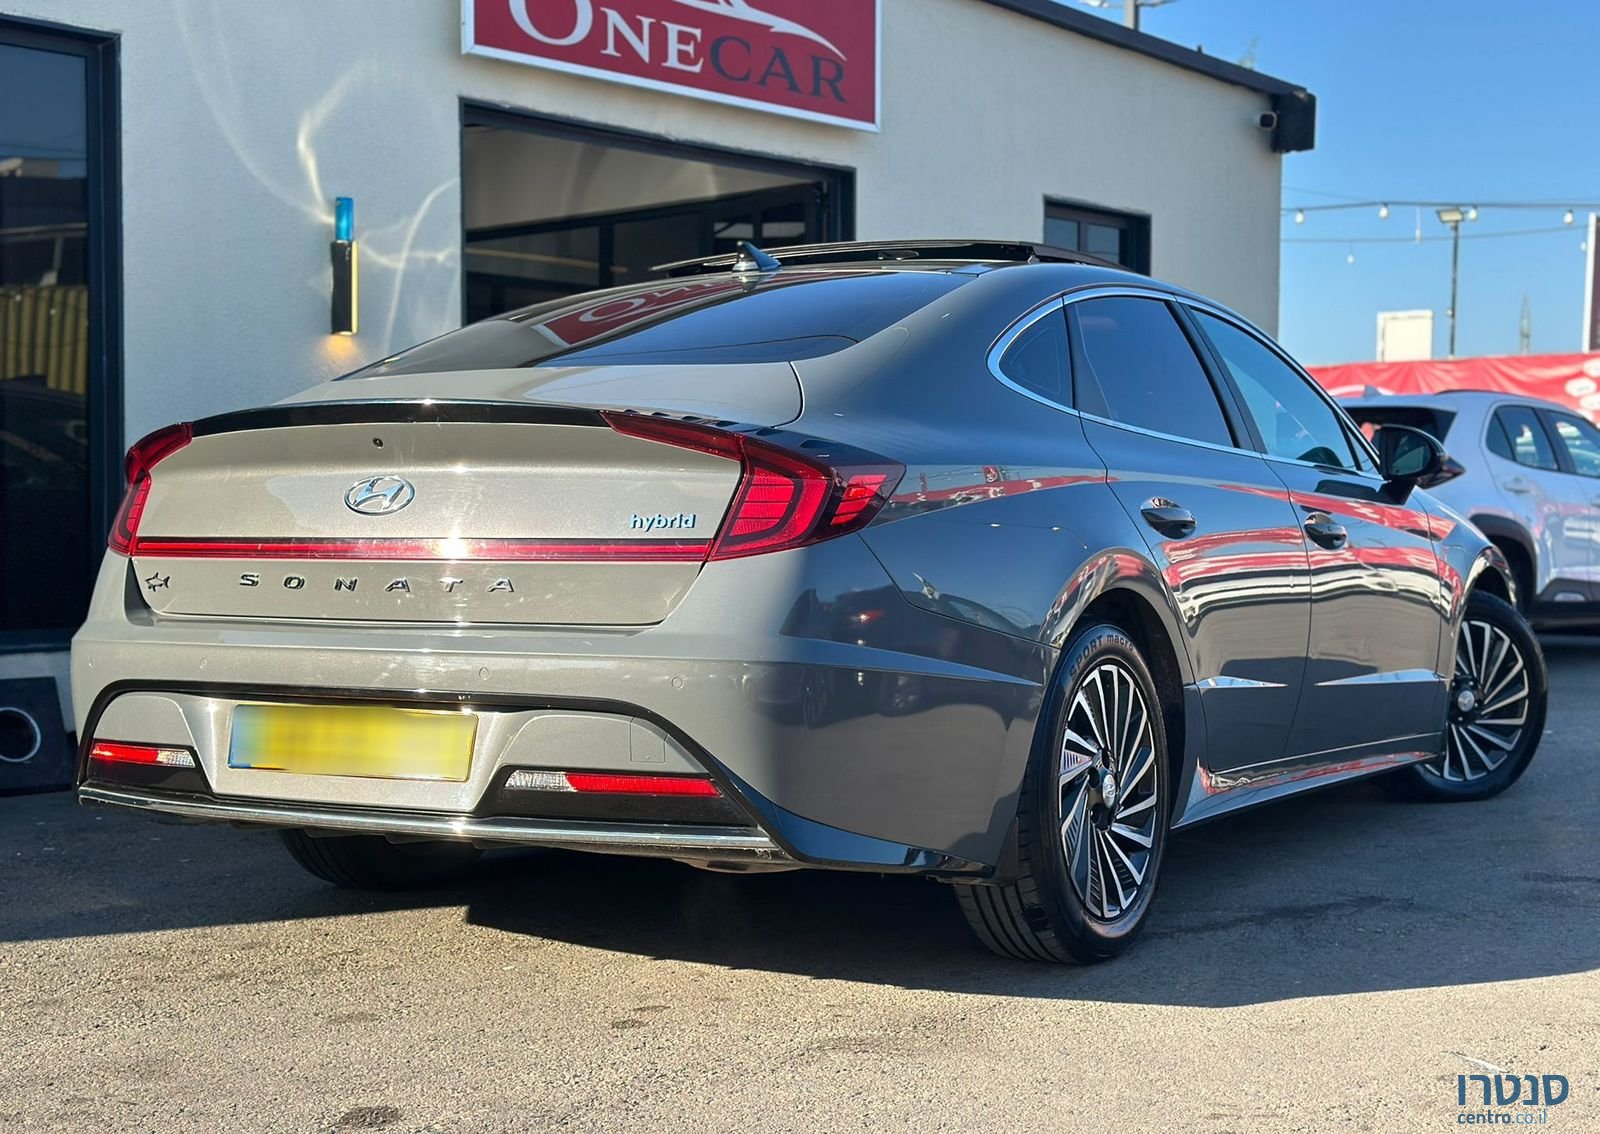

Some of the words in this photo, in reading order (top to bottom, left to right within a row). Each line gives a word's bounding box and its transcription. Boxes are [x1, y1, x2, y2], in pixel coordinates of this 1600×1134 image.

[629, 513, 696, 531] hybrid
[239, 573, 515, 592] SONATA
[1070, 634, 1102, 678] SPORT
